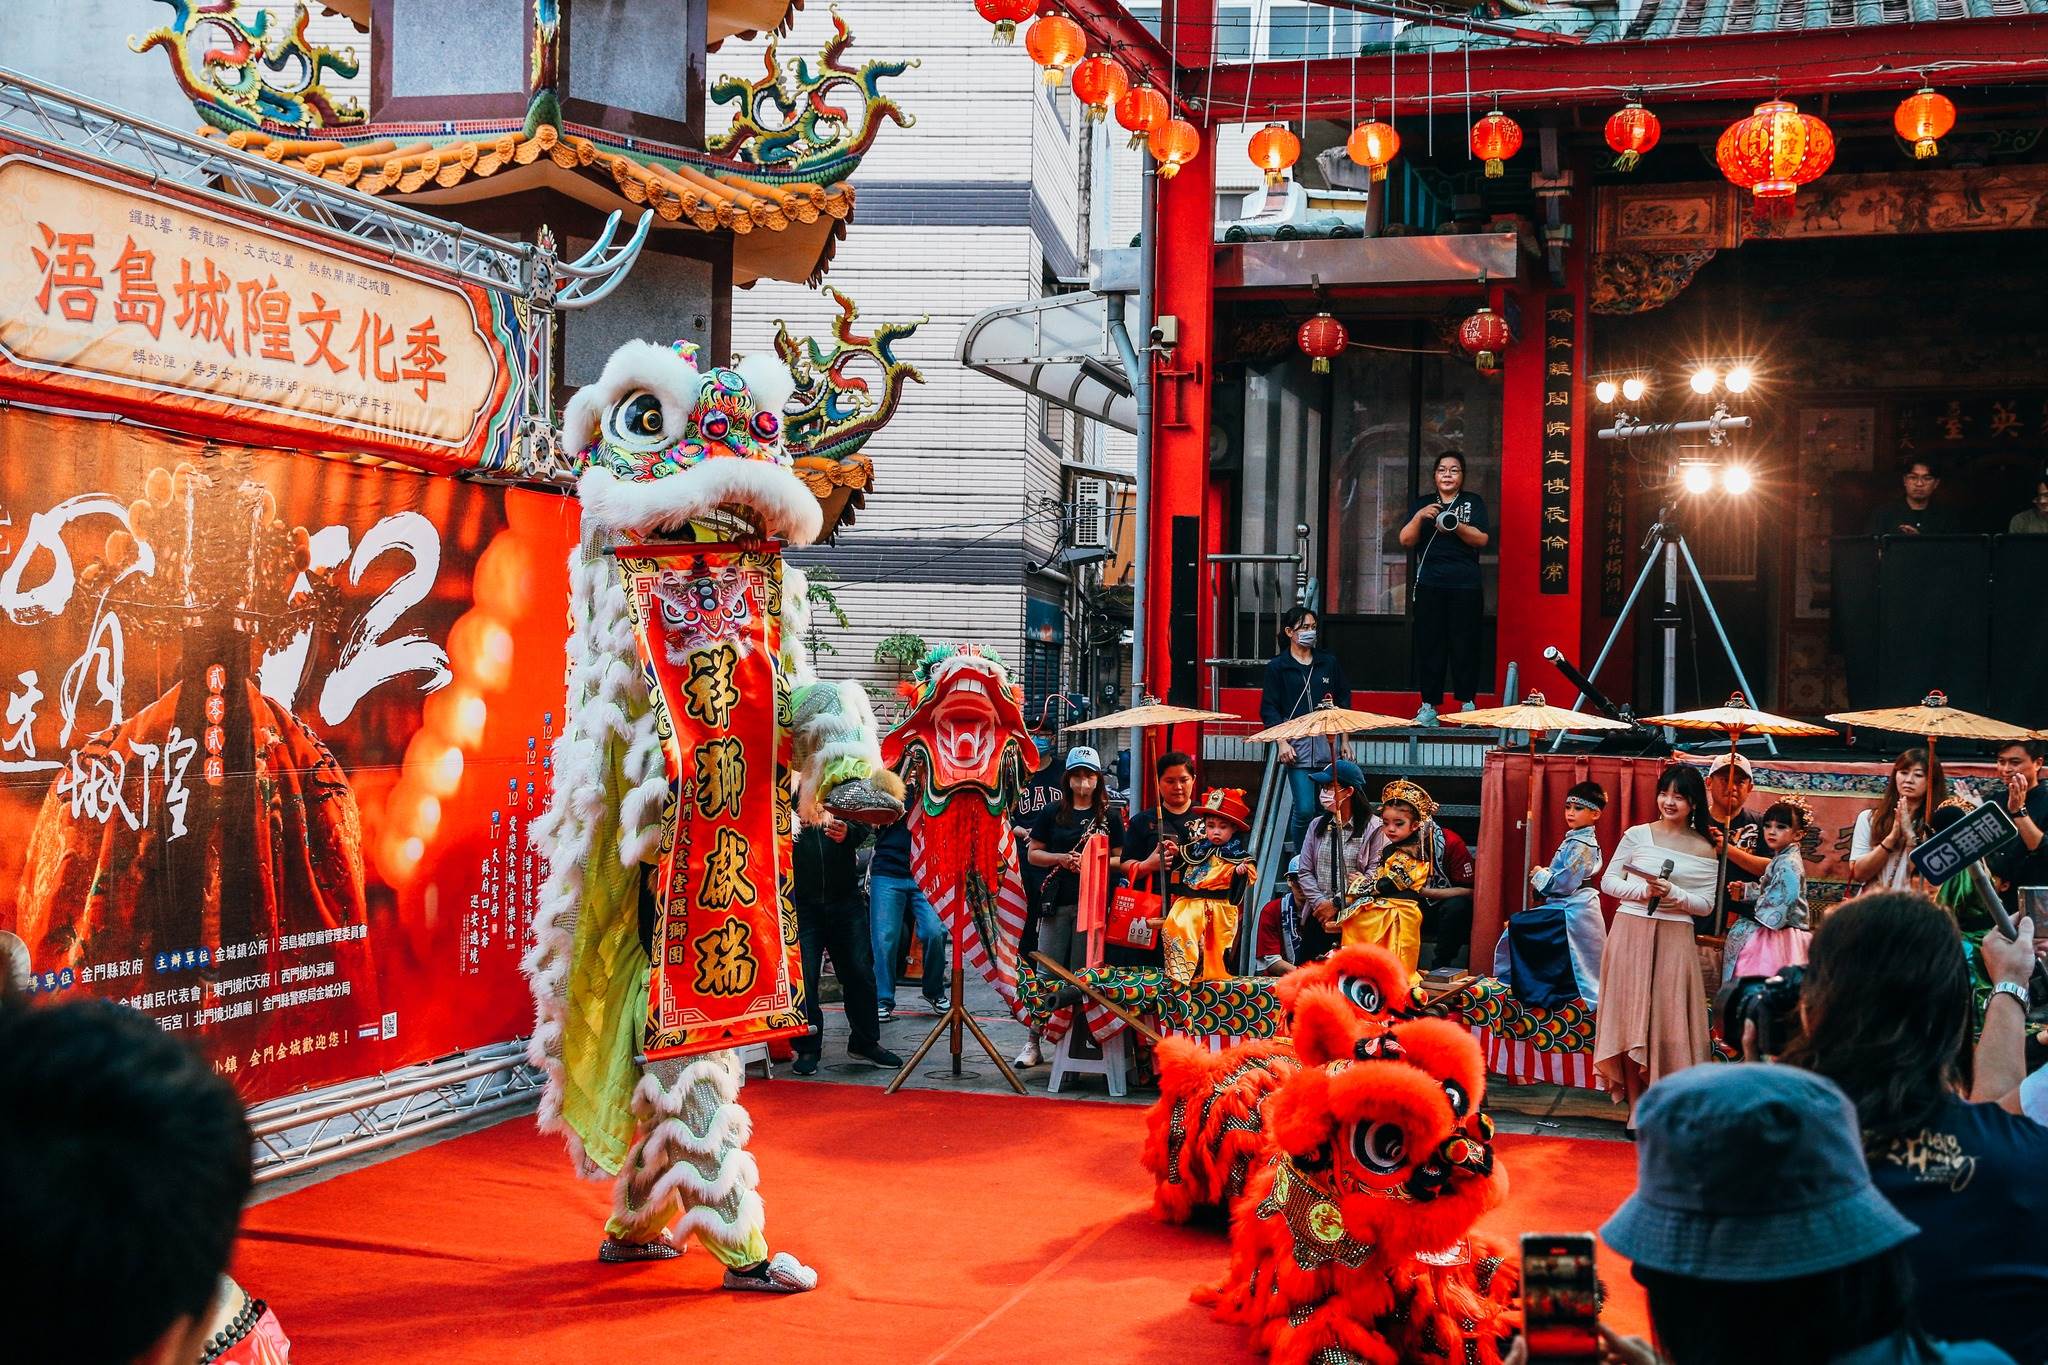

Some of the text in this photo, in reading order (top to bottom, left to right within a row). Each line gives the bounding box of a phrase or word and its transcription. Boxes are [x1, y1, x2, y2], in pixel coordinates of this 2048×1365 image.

[31, 222, 447, 403] 浯島城隍文化季
[206, 666, 225, 784] 貳零貳伍
[526, 750, 536, 765] 12
[508, 791, 518, 806] 12
[527, 797, 534, 811] 8
[685, 642, 760, 998] 祥獅獻瑞
[1951, 813, 2007, 857] 華視
[157, 950, 209, 970] 主辦單位
[215, 939, 268, 962] 金城鎮公所
[81, 959, 143, 983] 金門縣政府
[213, 972, 270, 997] 東門境代天府
[194, 1000, 252, 1025] 北門境北鎮廟
